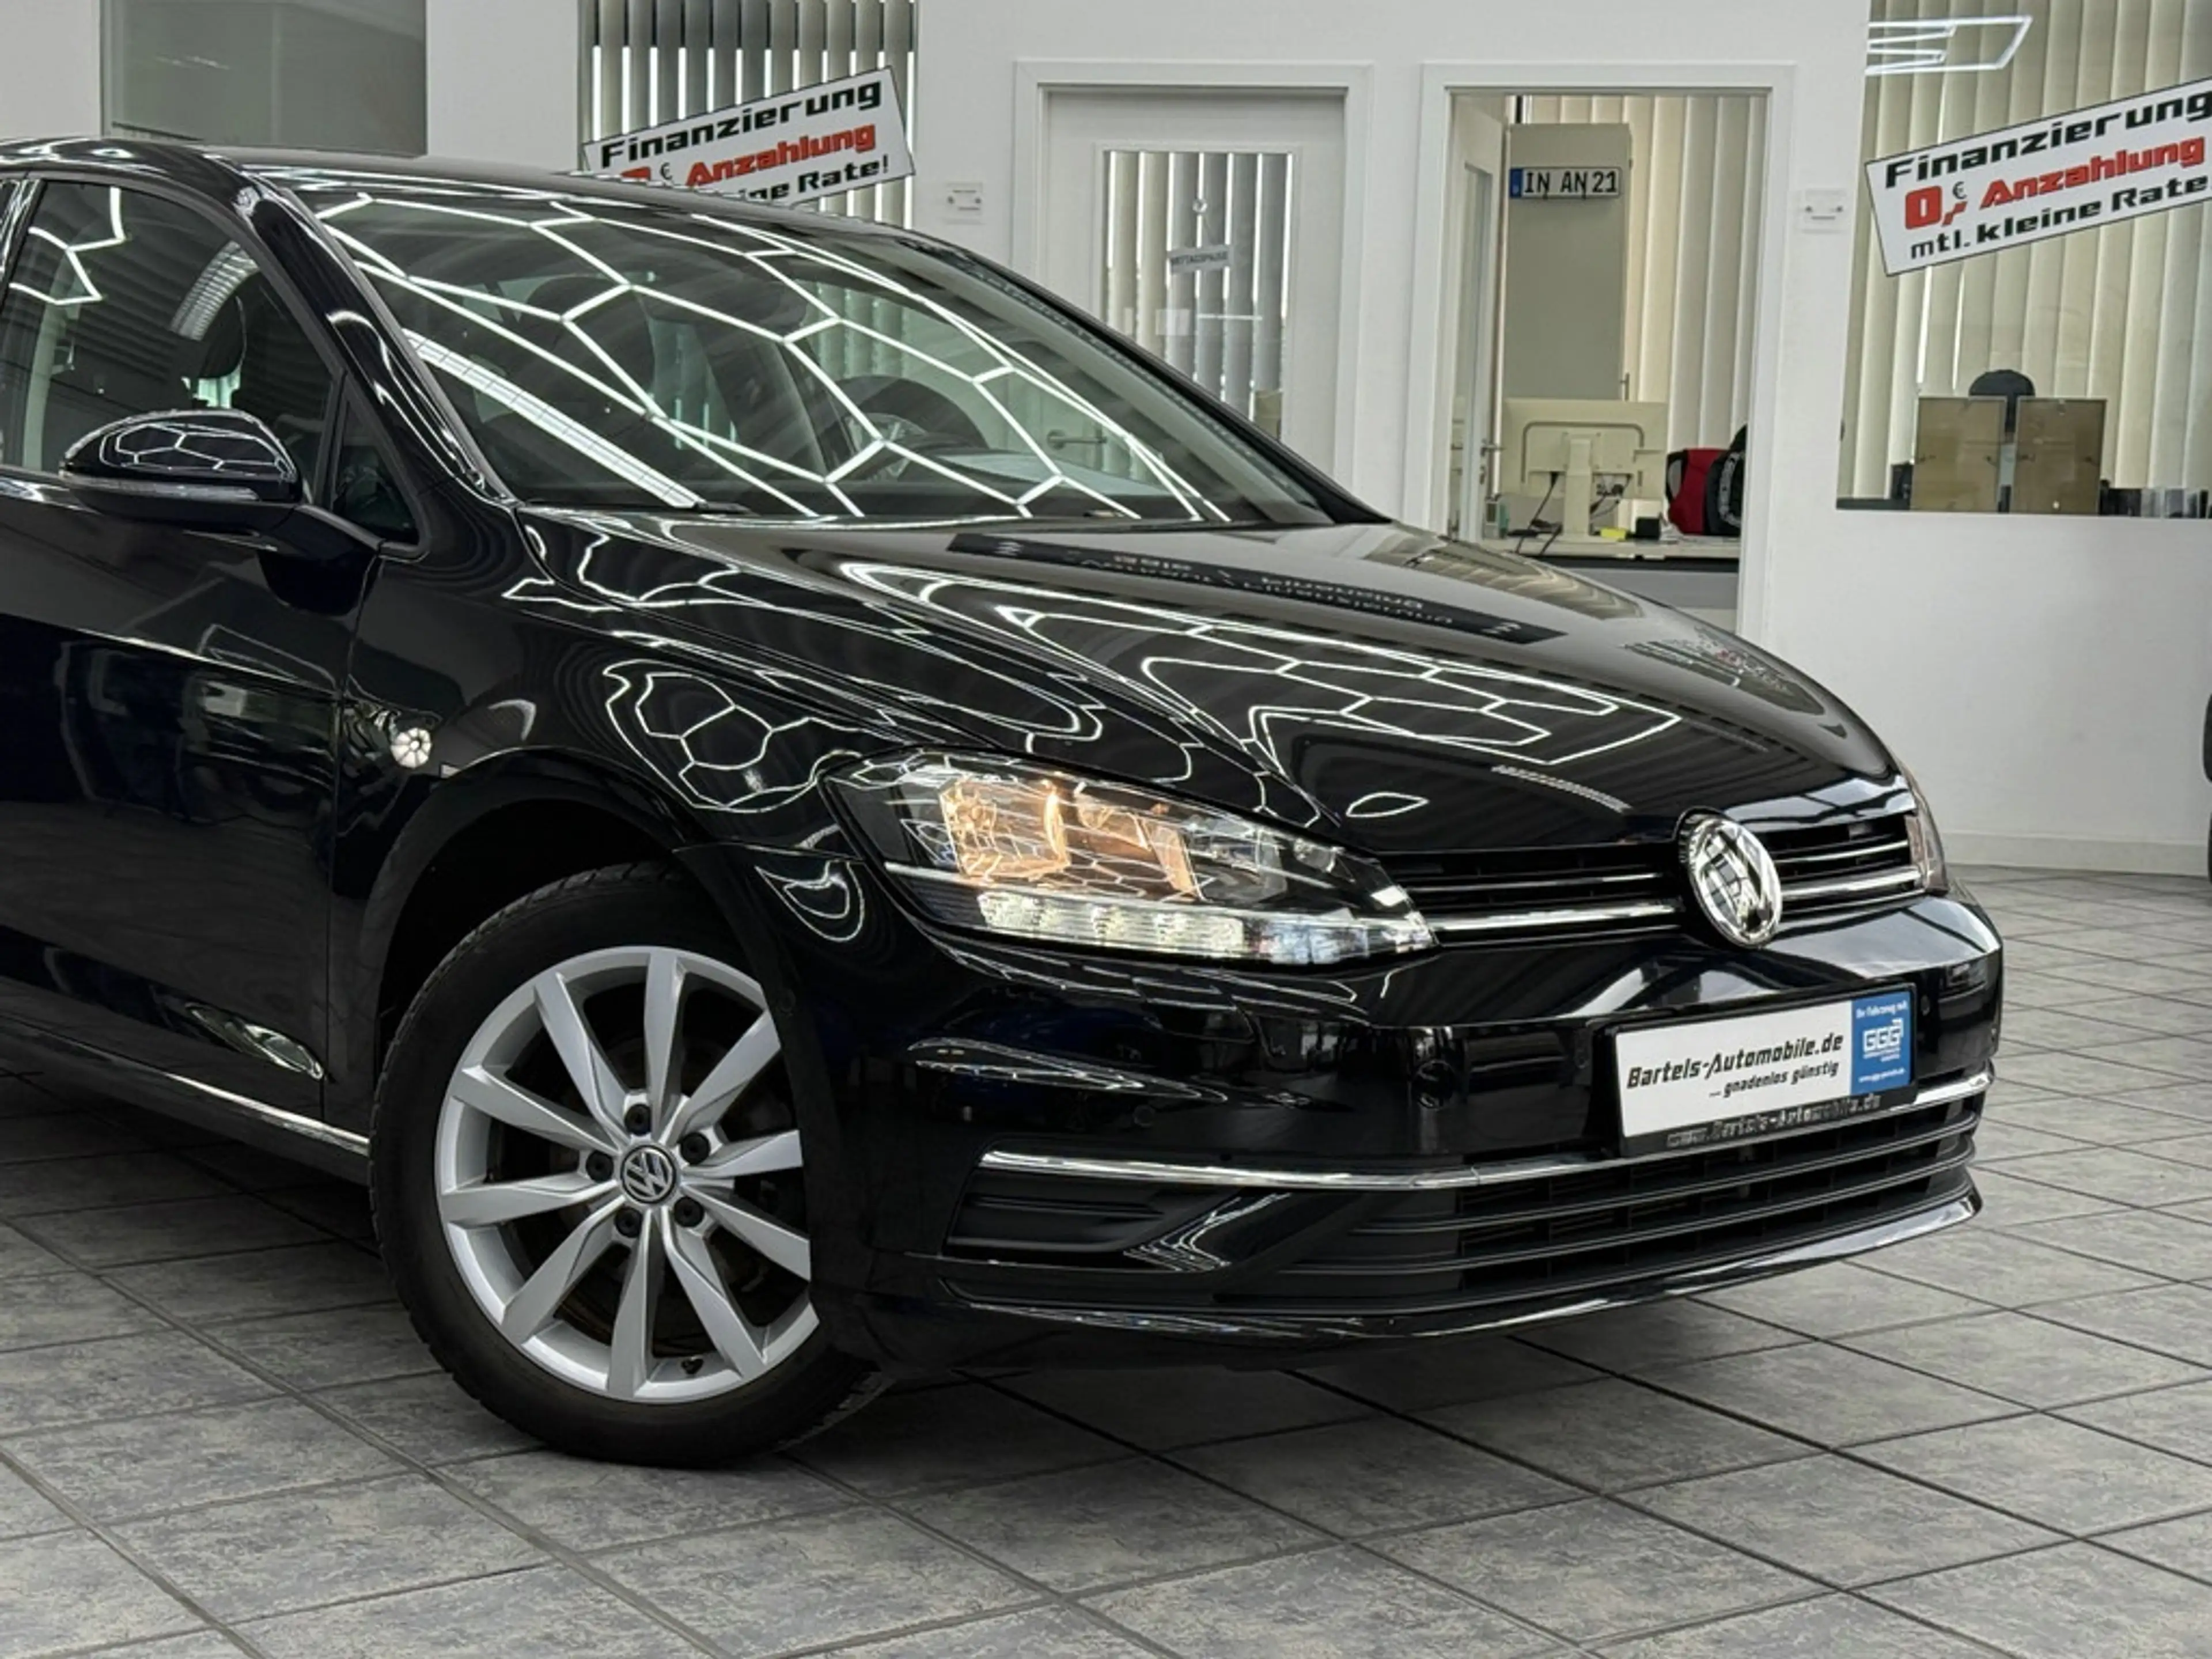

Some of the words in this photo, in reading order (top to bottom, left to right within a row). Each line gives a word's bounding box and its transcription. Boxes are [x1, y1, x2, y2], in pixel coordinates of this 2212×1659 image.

[601, 81, 881, 169] Finanzierung
[685, 124, 876, 186] Anzahlung
[1885, 90, 2212, 188] Finanzierung
[798, 154, 889, 193] Rate!
[1524, 171, 1551, 193] IN
[1979, 136, 2206, 209] Anzahlung
[1910, 229, 1971, 260] mtl.
[1976, 199, 2101, 244] kleine
[2112, 175, 2209, 213] Rate
[1627, 1032, 1844, 1089] Bartels-Automobile.de
[1723, 1071, 1789, 1098] gnadenlos
[1790, 1060, 1839, 1085] günstig
